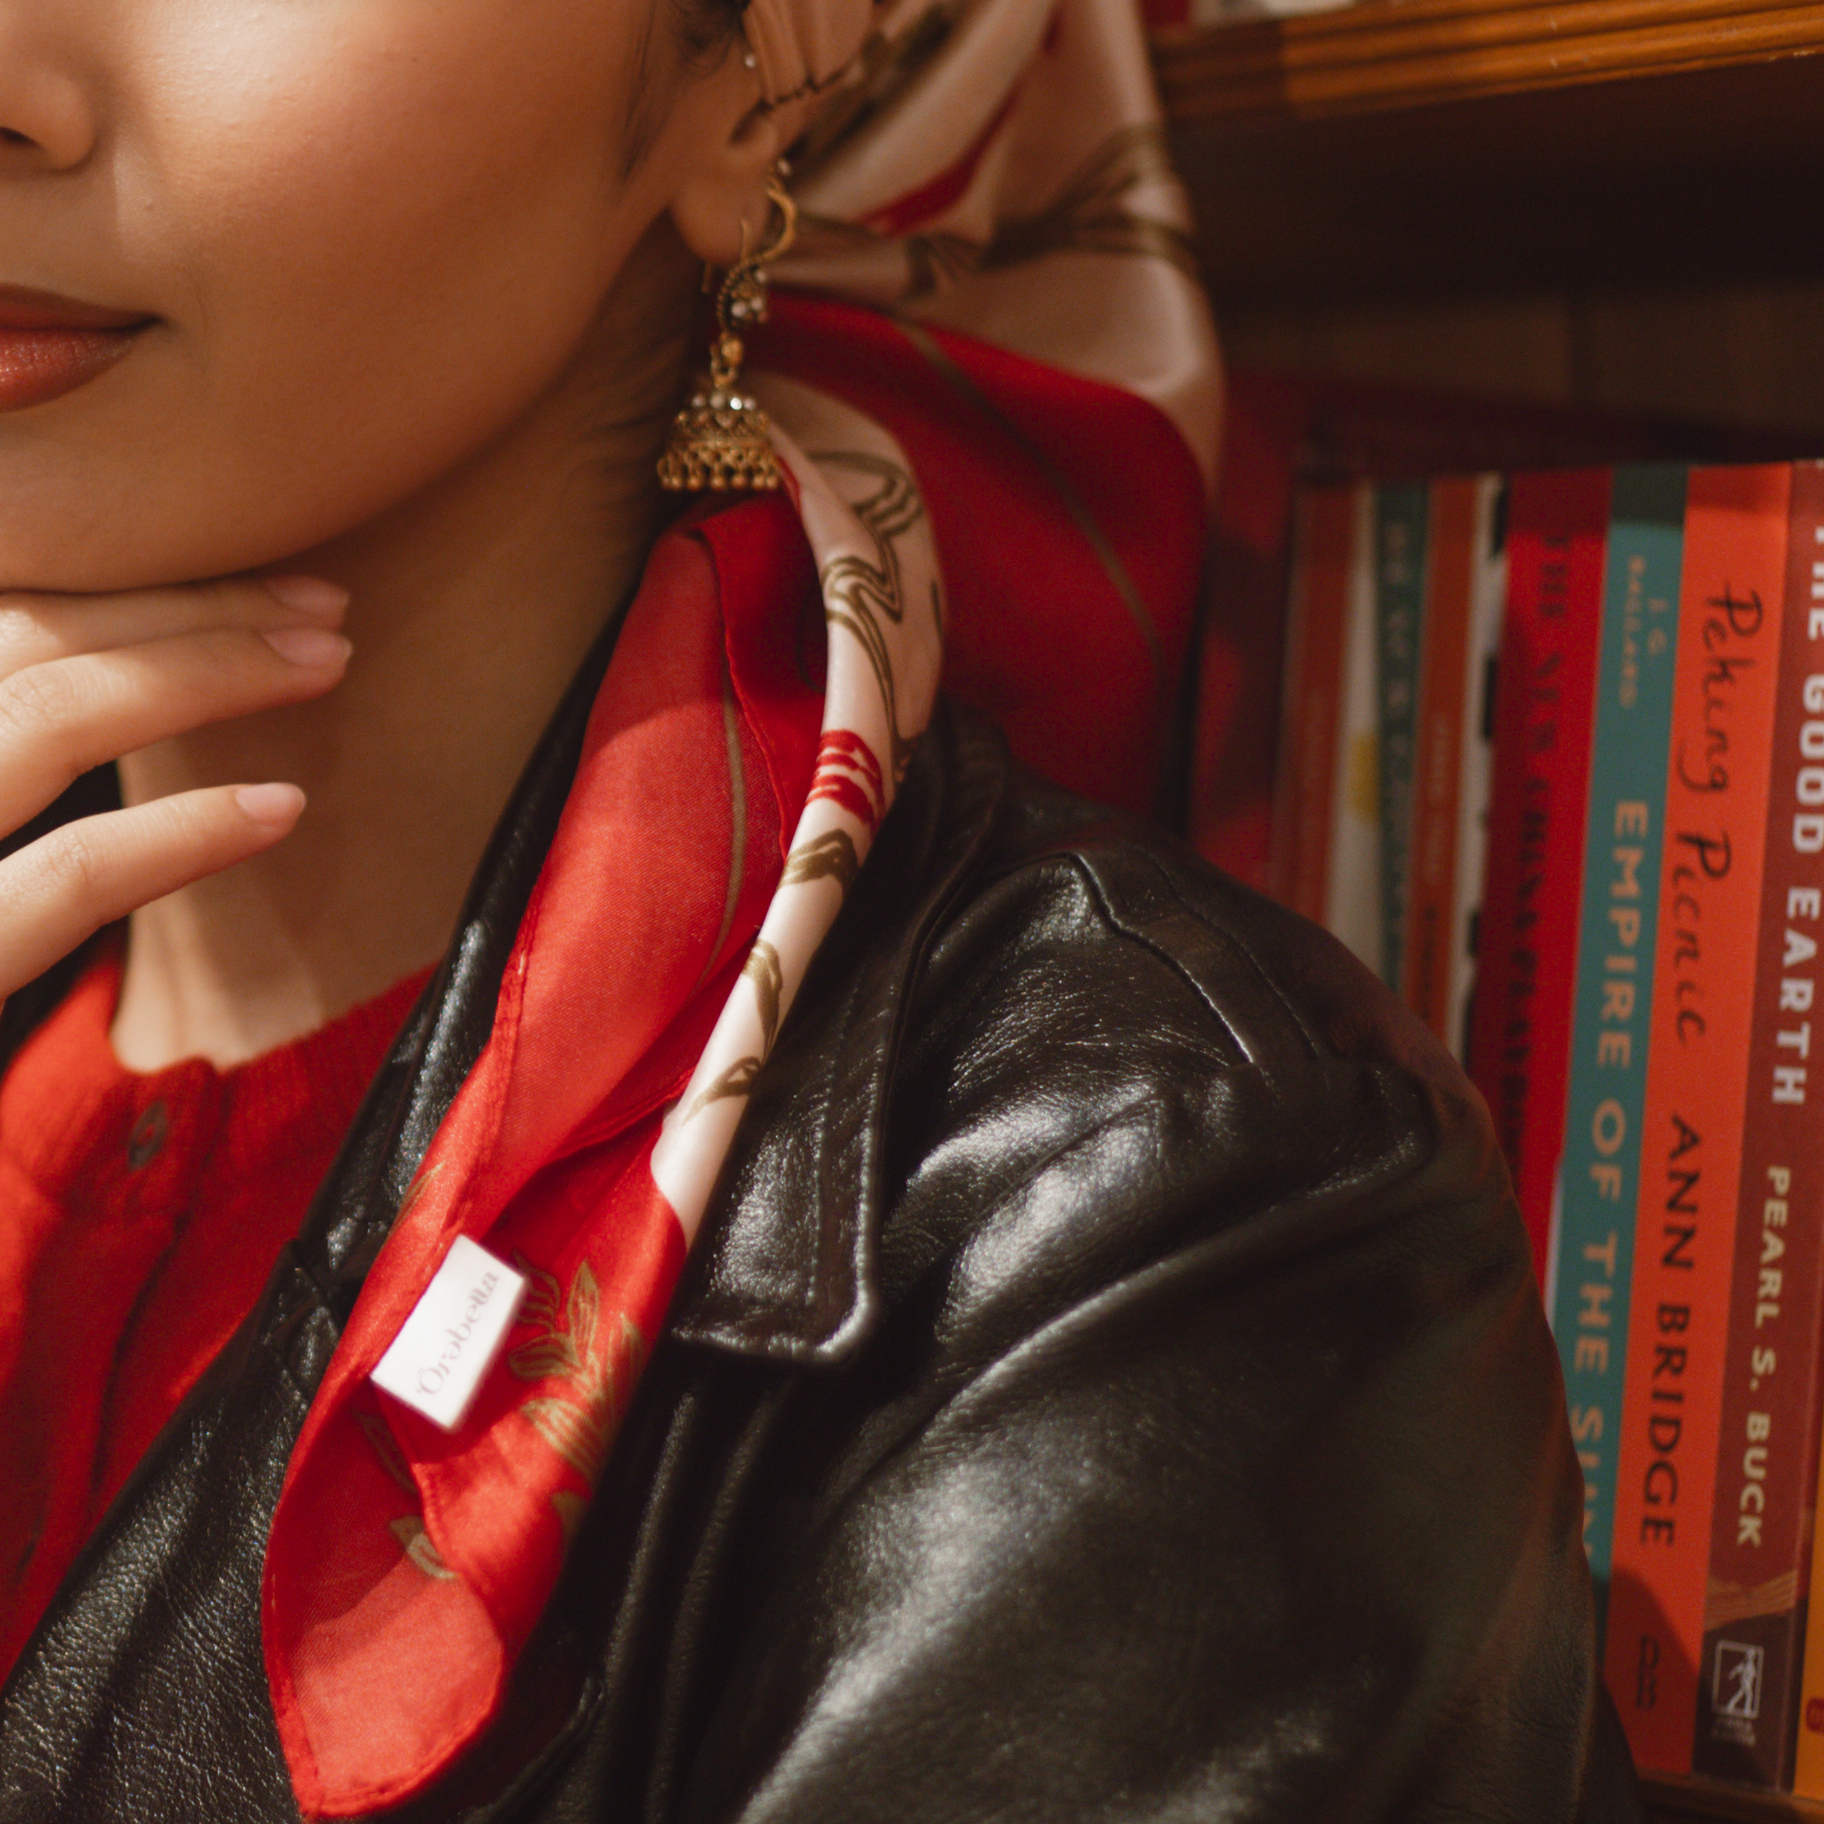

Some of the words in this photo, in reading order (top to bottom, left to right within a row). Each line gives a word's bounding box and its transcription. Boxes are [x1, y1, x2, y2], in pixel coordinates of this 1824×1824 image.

[1679, 583, 1765, 794] Peking
[1791, 674, 1824, 854] GOOD
[1597, 799, 1650, 1070] EMPIRE
[1673, 829, 1733, 1046] Picnic
[1772, 885, 1823, 1105] EARTH
[1588, 1098, 1628, 1204] OF
[1661, 1113, 1703, 1272] ANN
[1573, 1231, 1618, 1375] THE
[1754, 1164, 1792, 1327] PEARL
[1639, 1301, 1692, 1549] BRIDGE
[1748, 1348, 1776, 1392] S.
[1736, 1413, 1771, 1549] BUCK
